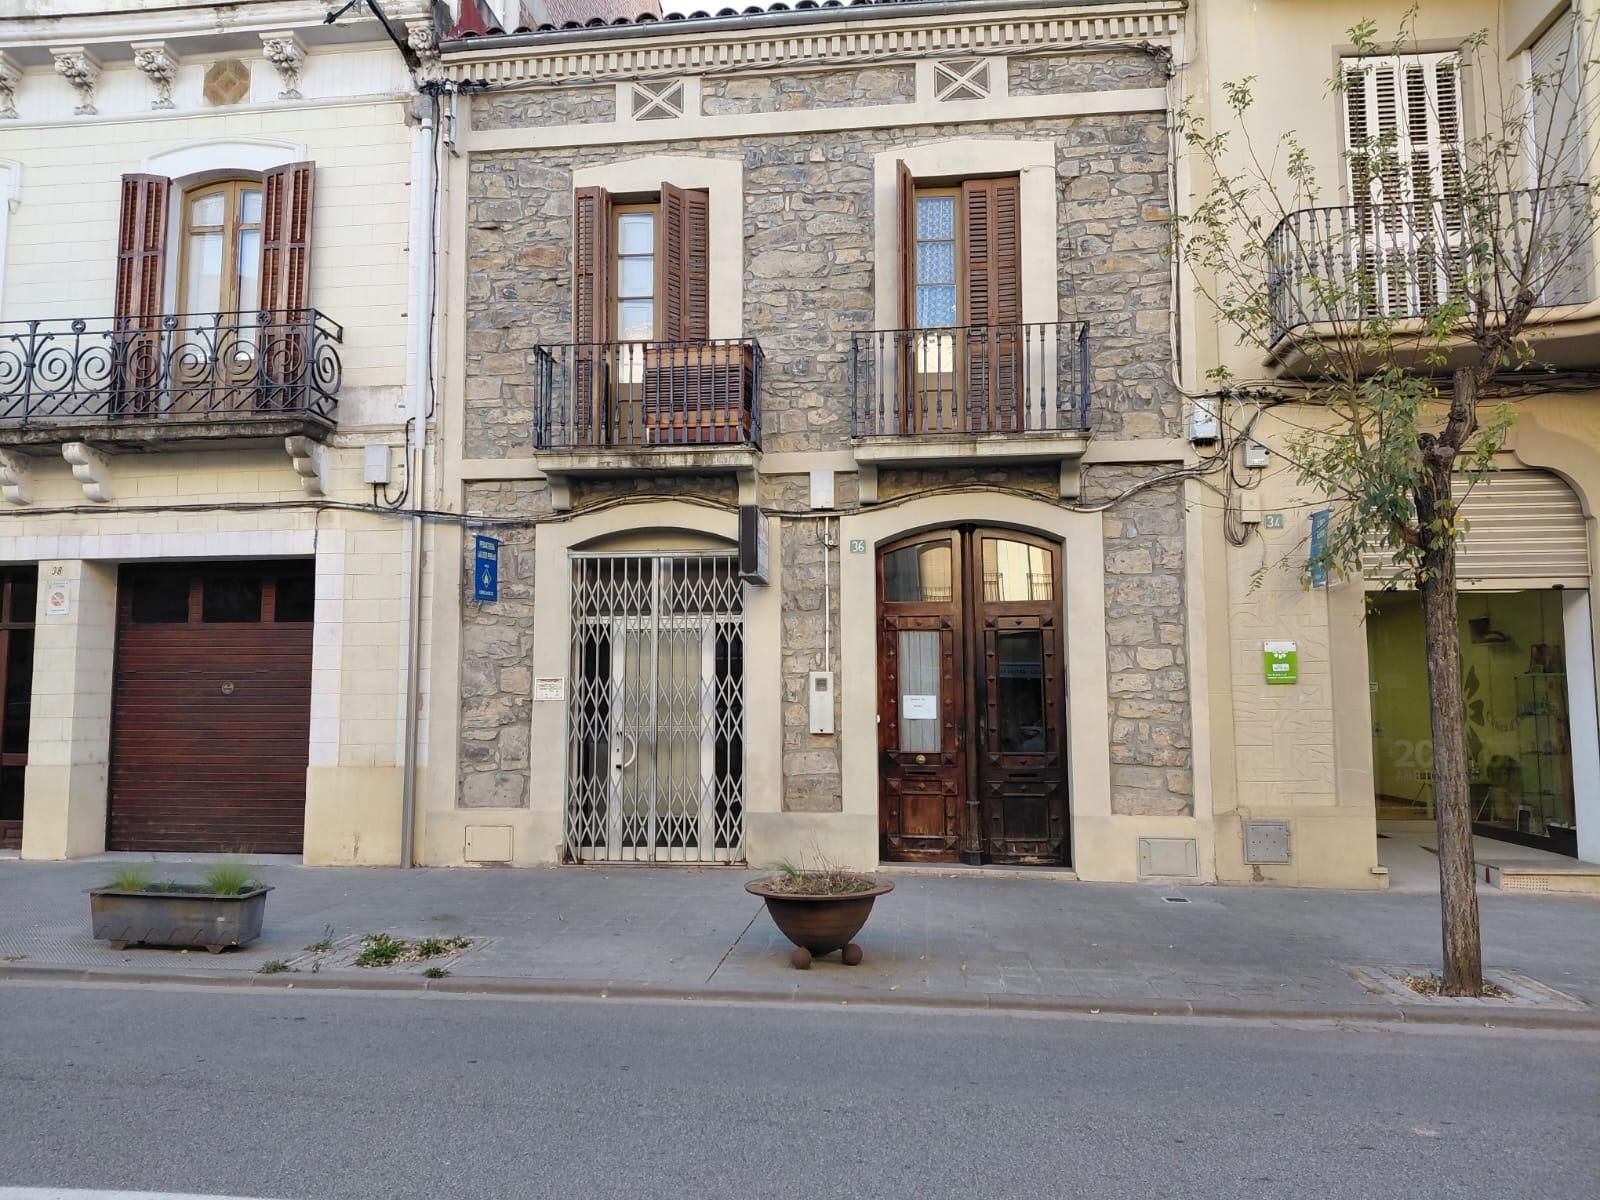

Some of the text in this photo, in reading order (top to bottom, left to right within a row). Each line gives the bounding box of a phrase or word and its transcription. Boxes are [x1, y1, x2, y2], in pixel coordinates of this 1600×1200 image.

[1267, 515, 1280, 527] 34
[852, 540, 865, 552] 36
[51, 566, 63, 576] 38
